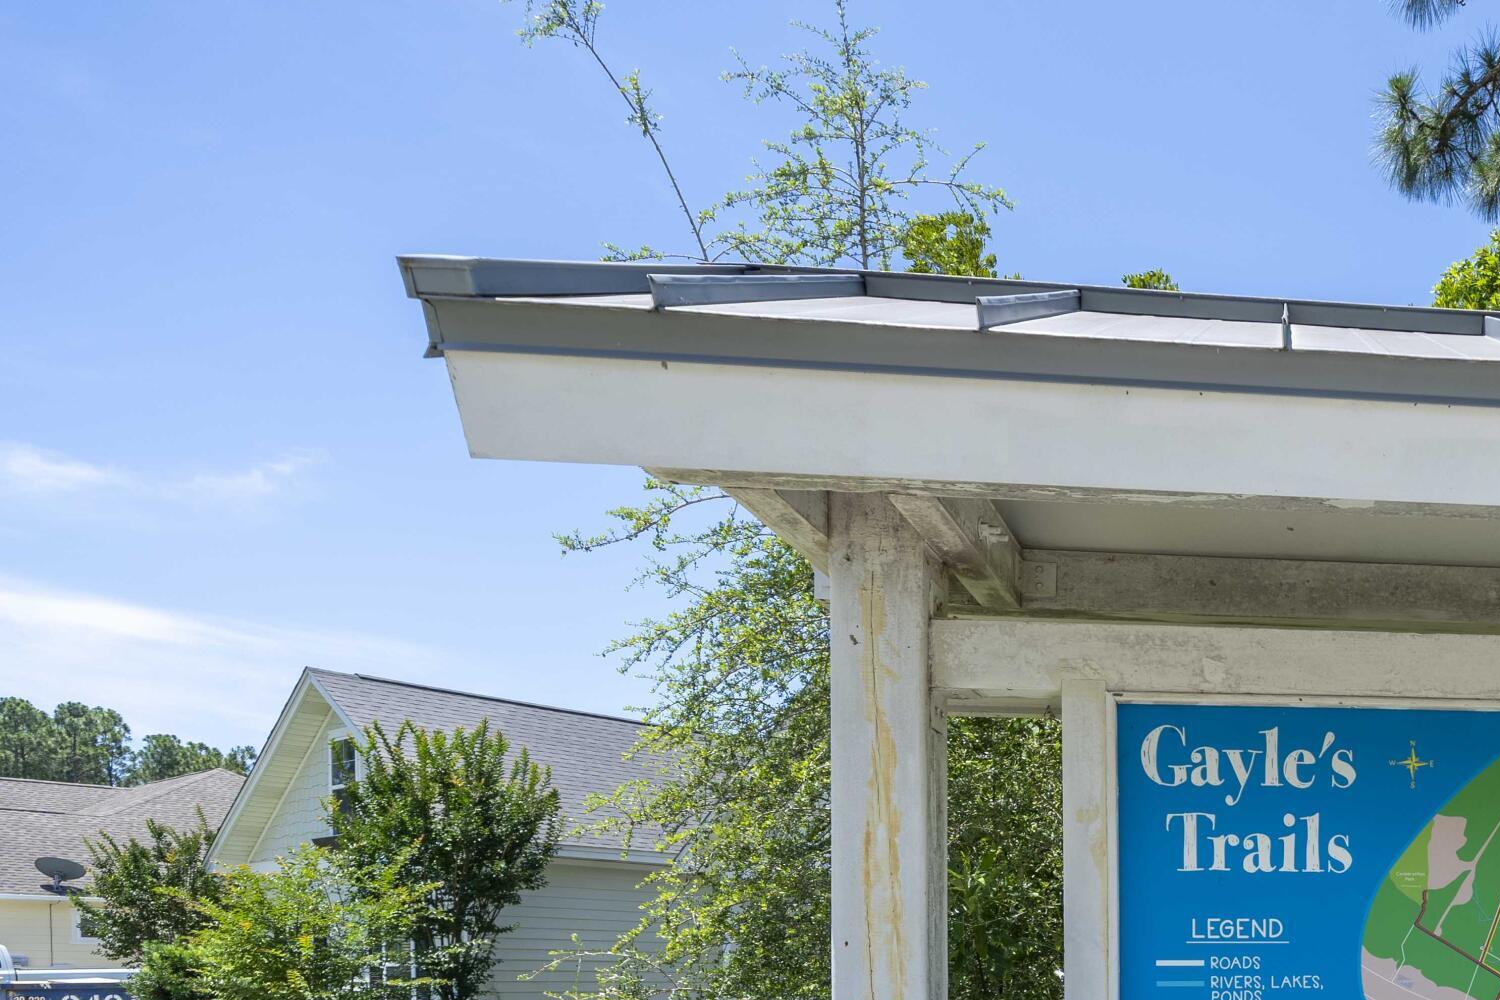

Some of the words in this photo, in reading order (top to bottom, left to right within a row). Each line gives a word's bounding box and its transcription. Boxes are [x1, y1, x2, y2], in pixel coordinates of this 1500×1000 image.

[1409, 740, 1416, 748] N
[1140, 724, 1357, 806] Gayle's
[1388, 759, 1397, 767] W
[1410, 781, 1416, 789] S
[1166, 812, 1353, 873] Trails
[1191, 918, 1284, 939] LEGEND
[1210, 956, 1261, 969] ROADS
[1210, 975, 1265, 990] RIVERS,
[1271, 975, 1324, 990] LAKES,
